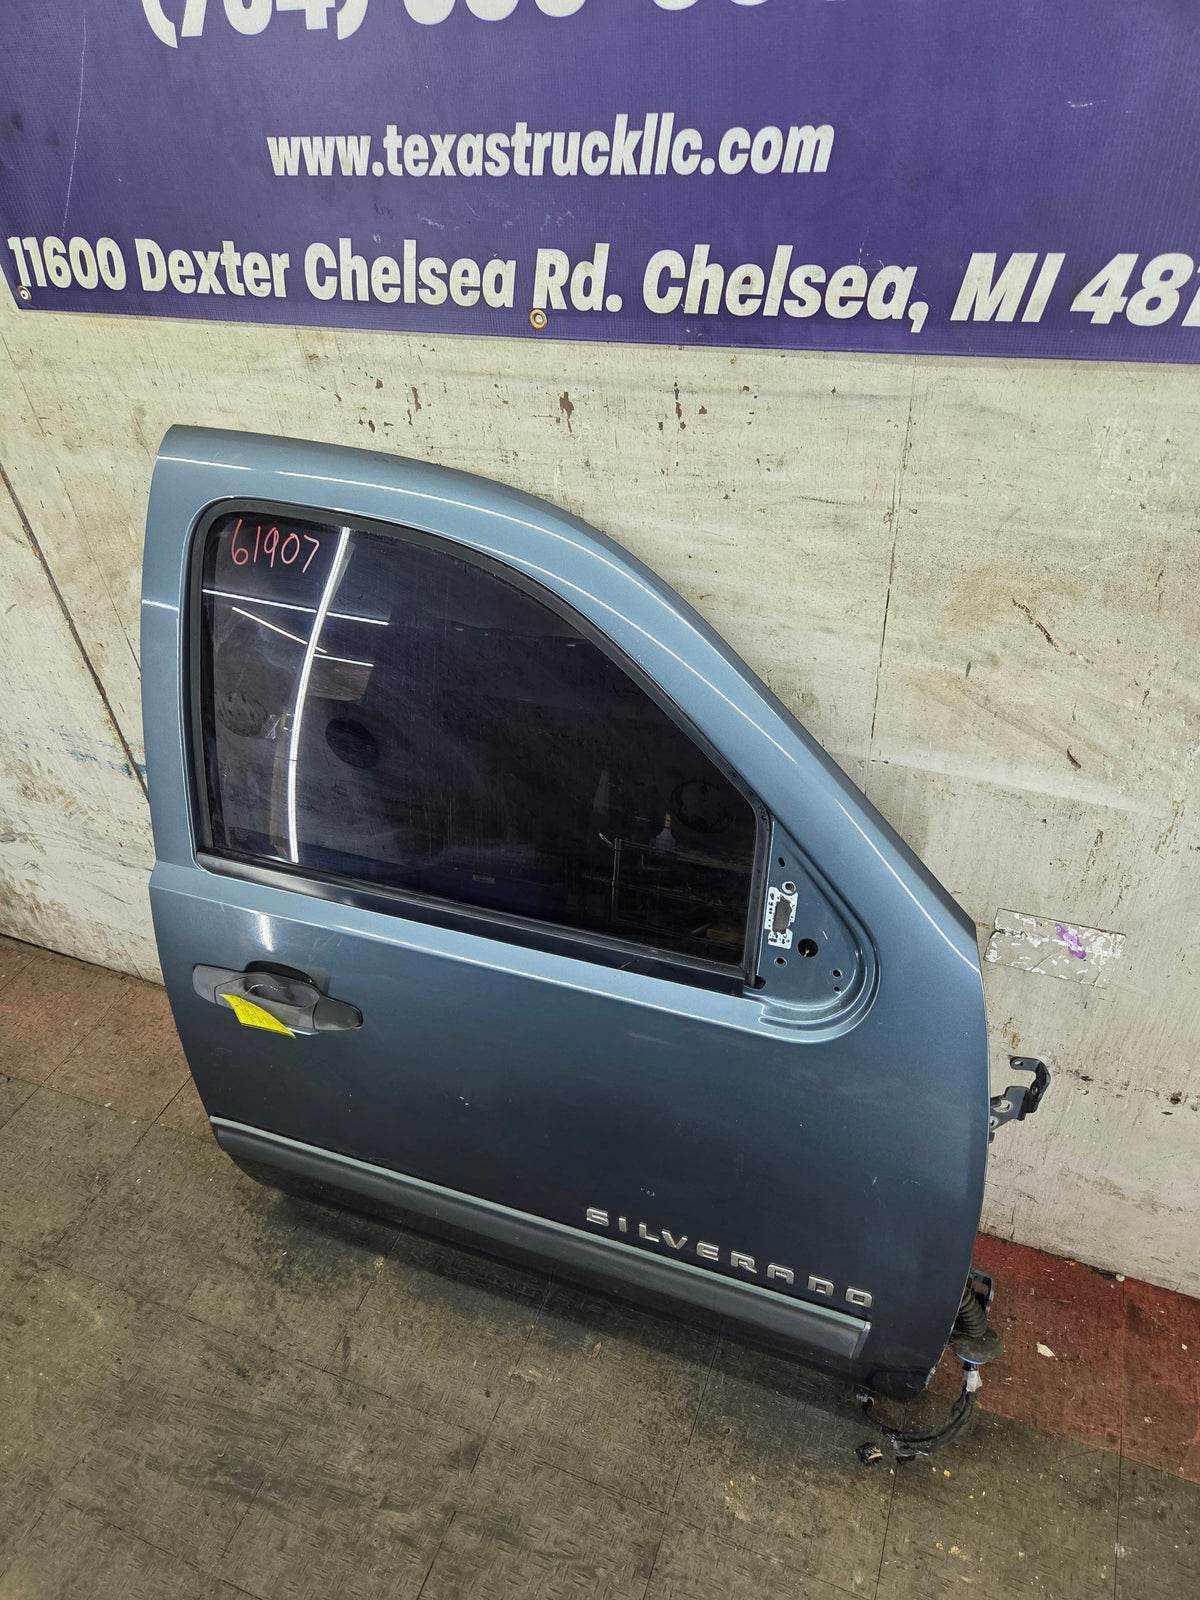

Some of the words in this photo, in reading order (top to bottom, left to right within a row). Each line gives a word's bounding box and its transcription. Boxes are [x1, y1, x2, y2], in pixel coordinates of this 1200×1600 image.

[266, 112, 835, 177] www.texastruckllc.com
[7, 235, 127, 291] 11600
[134, 238, 290, 298] Dexter
[304, 237, 517, 308] Chelsea
[532, 242, 623, 313] Rd.
[642, 243, 929, 333] Chelsea,
[949, 252, 1066, 323] MI
[231, 518, 320, 573] 61907
[586, 1206, 873, 1308] SILVERADO
